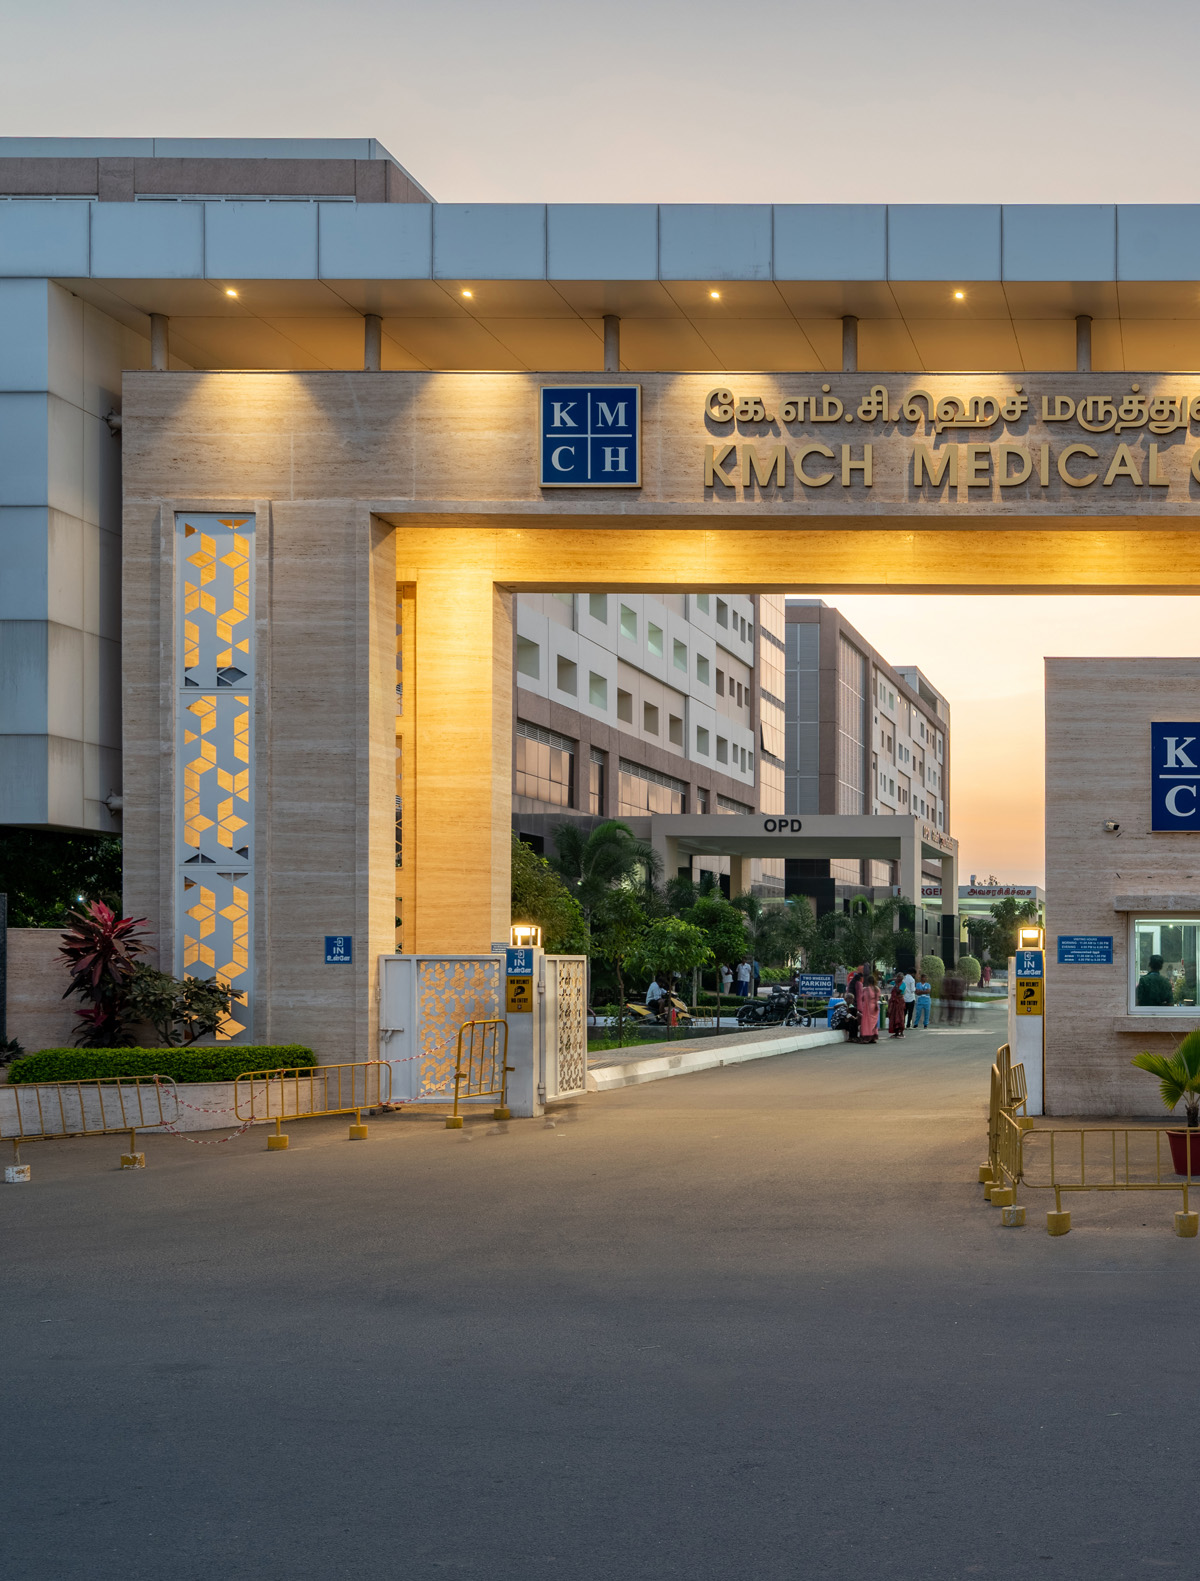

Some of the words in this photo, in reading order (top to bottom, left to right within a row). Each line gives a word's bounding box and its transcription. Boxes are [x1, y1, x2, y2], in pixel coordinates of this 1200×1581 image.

[704, 444, 873, 487] KMCH
[913, 443, 1170, 488] MEDICAL
[764, 818, 802, 833] OPD
[514, 959, 525, 967] IN
